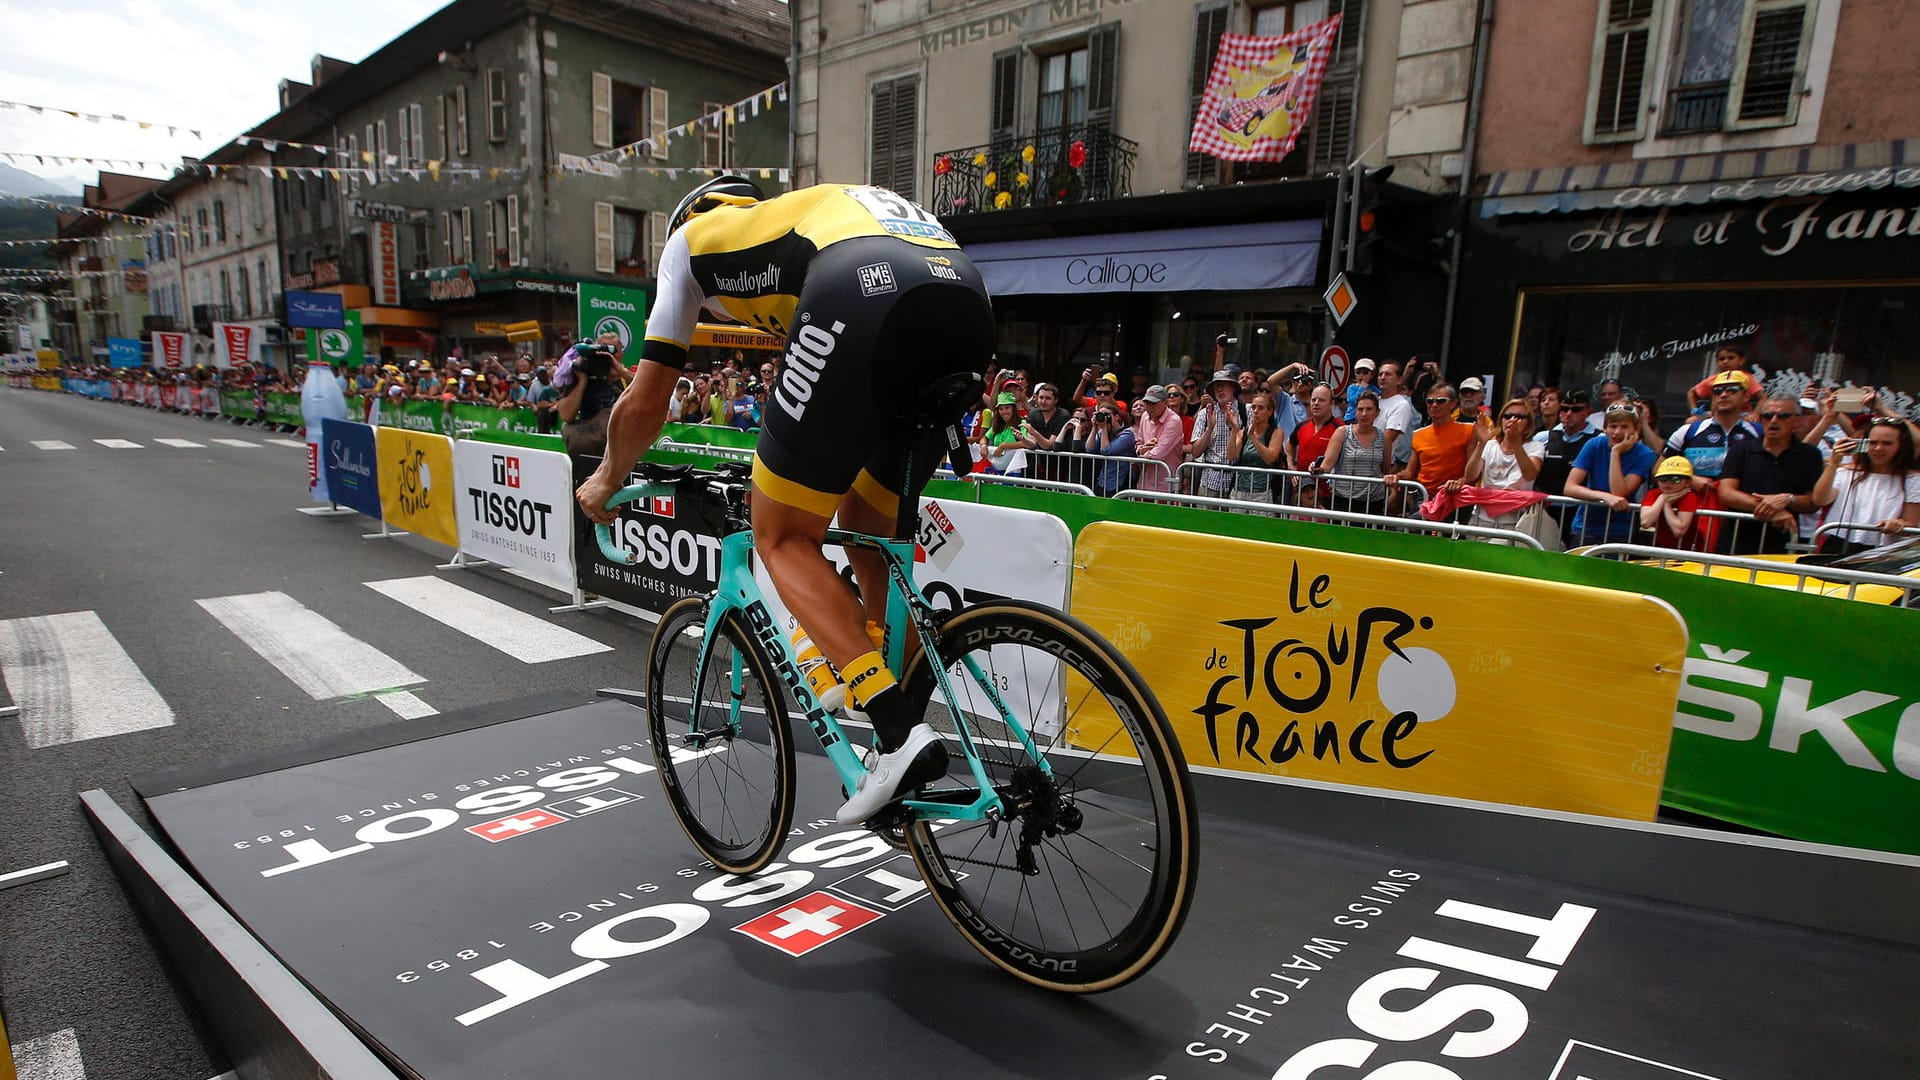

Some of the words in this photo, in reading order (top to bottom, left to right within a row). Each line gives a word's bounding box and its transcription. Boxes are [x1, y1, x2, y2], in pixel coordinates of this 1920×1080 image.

[919, 12, 1026, 53] MAISON
[1711, 178, 1755, 199] et
[1568, 205, 1670, 253] Art
[1693, 209, 1738, 245] et
[713, 262, 781, 294] brandloyalty
[861, 264, 892, 288] SMS
[866, 283, 893, 294] Santini
[1065, 256, 1168, 291] Calliope
[589, 297, 636, 312] ŠKODA
[712, 333, 755, 346] BOUTIQUE
[1594, 350, 1637, 371] Art
[1639, 346, 1660, 361] et
[1661, 322, 1761, 359] Fantaisie
[774, 320, 846, 422] Lotto.
[468, 487, 552, 540] TISSOT
[927, 502, 951, 532] Vittel
[491, 535, 518, 552] WATCHES
[519, 543, 538, 559] SINCE
[539, 550, 556, 564] 1853
[612, 516, 722, 583] ISSOT
[920, 521, 947, 557] 57
[593, 562, 621, 581] SWISS
[623, 571, 665, 594] WATCHES
[1289, 559, 1333, 613] Le
[966, 625, 1103, 683] DURA-ACE
[1204, 646, 1229, 670] de
[743, 599, 841, 748] Bianchi
[848, 666, 879, 691] MBO
[600, 732, 681, 755] SISS
[455, 754, 592, 792] WATCHES
[260, 743, 729, 878] TISSOT
[335, 792, 439, 824] SINCE
[233, 824, 316, 850] 1853
[528, 882, 660, 934] SINCE
[1332, 868, 1422, 930] SWISS
[953, 900, 1077, 974] DURA-ACE
[395, 939, 507, 984] 1853
[1184, 936, 1350, 1064] WATCHES
